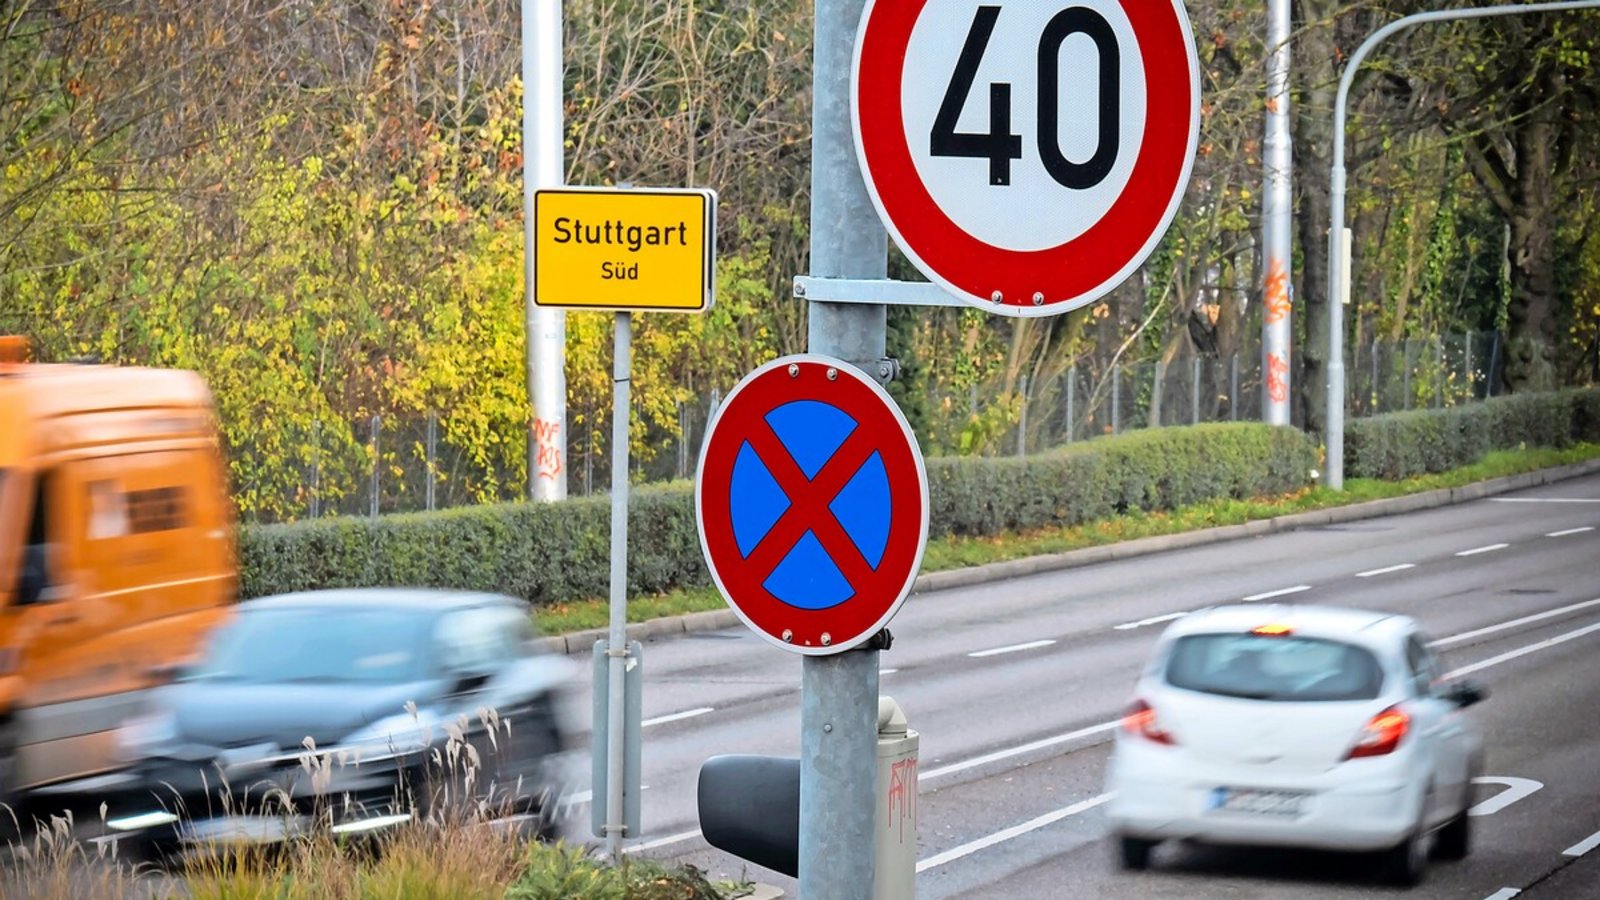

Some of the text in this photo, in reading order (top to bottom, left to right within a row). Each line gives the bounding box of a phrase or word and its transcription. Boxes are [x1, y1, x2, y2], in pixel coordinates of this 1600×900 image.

[930, 6, 1120, 190] 40
[553, 217, 687, 252] Stuttgart
[601, 262, 638, 280] Süd
